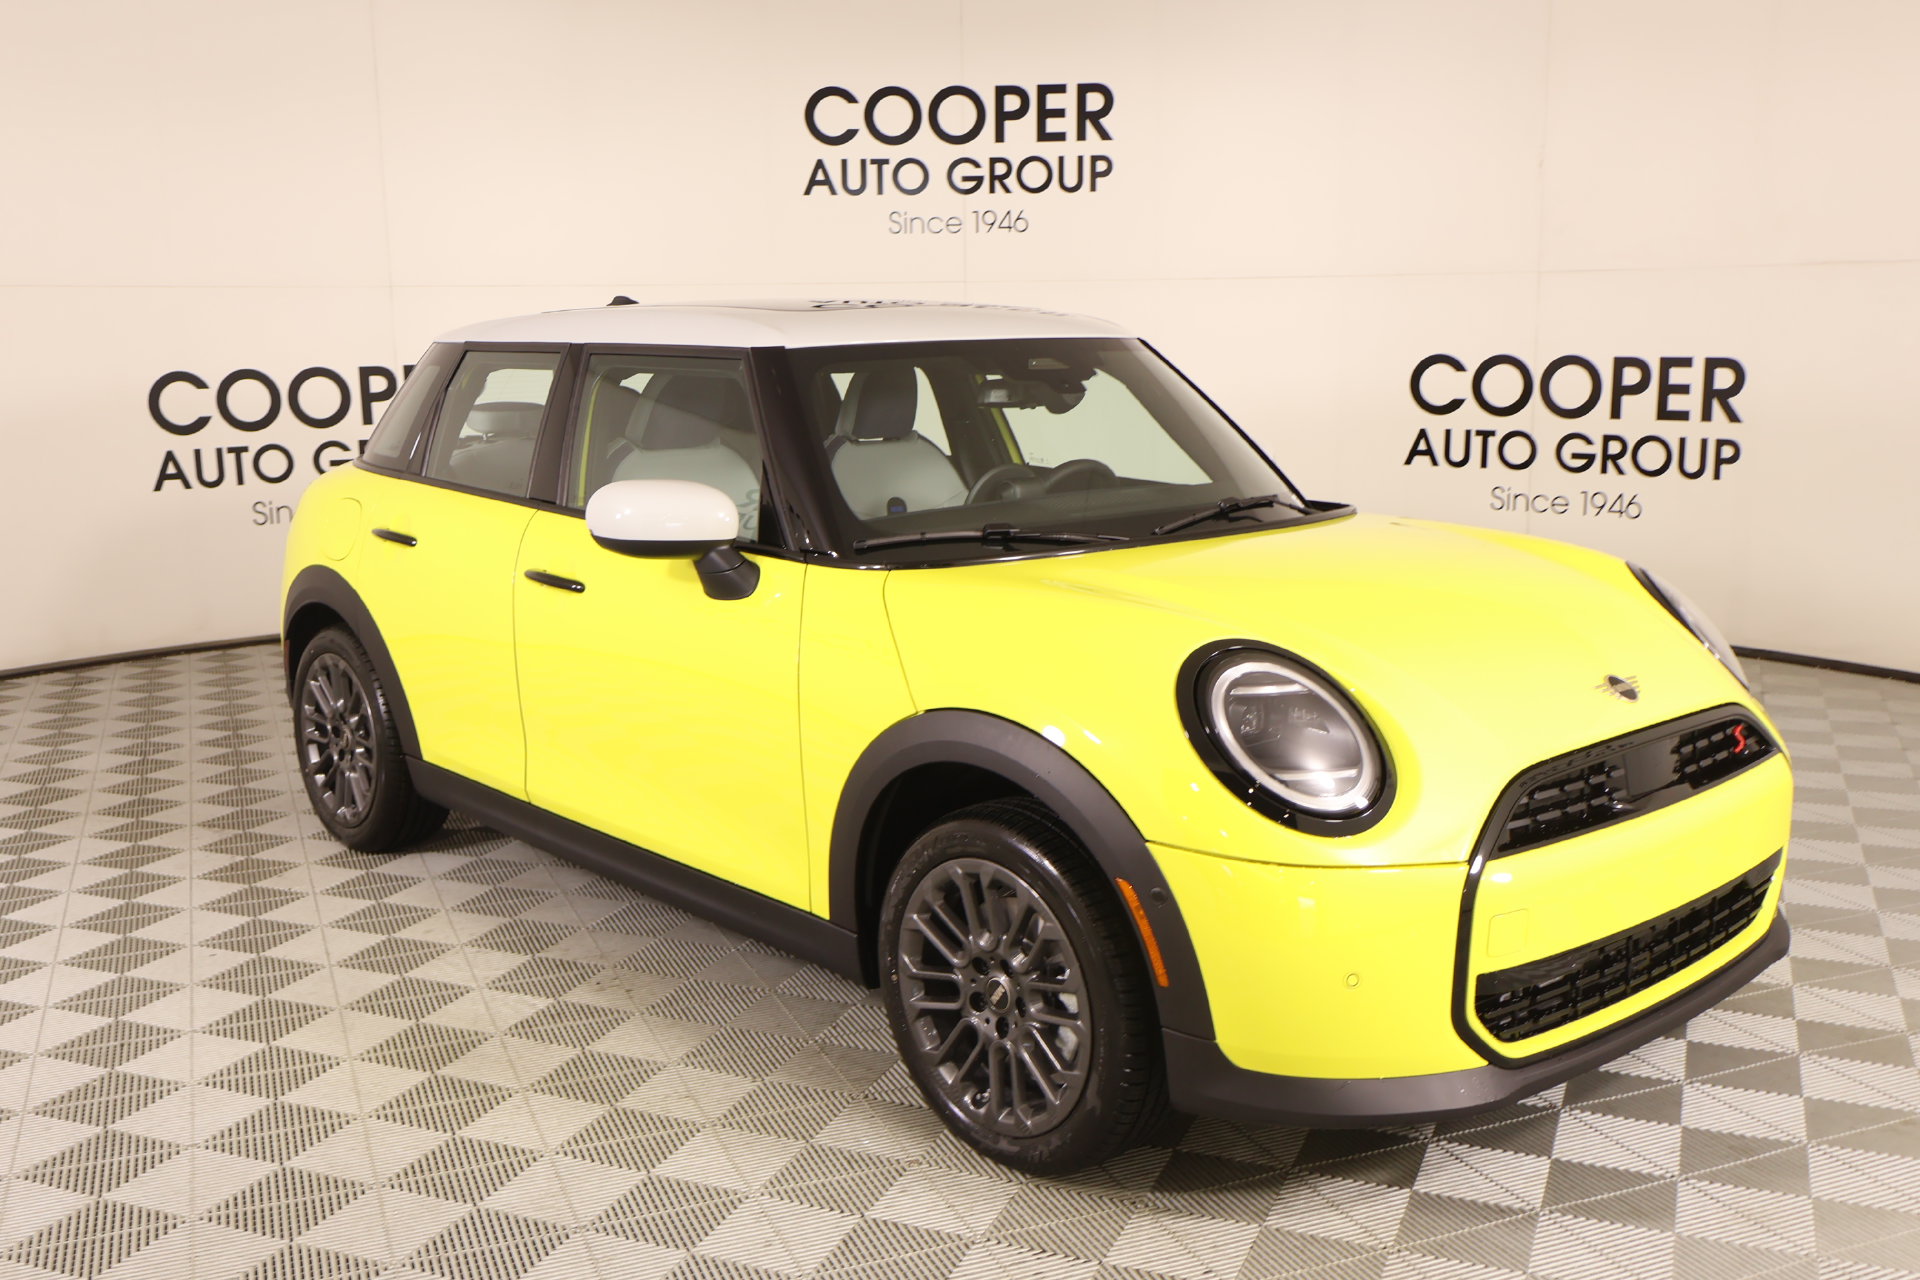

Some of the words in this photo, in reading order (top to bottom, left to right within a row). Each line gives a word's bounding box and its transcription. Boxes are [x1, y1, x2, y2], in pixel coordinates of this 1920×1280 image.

[804, 83, 1114, 145] COOPER
[803, 157, 930, 196] AUTO
[946, 154, 1113, 195] GROUP
[888, 210, 963, 235] Since
[971, 208, 1030, 234] 1946
[148, 364, 417, 436] COOP
[1410, 353, 1746, 423] COOPER
[153, 443, 294, 492] AUTO
[1404, 428, 1537, 471] AUTO
[1555, 432, 1742, 481] GROUP
[1489, 485, 1570, 515] Since
[1579, 490, 1643, 520] 1946
